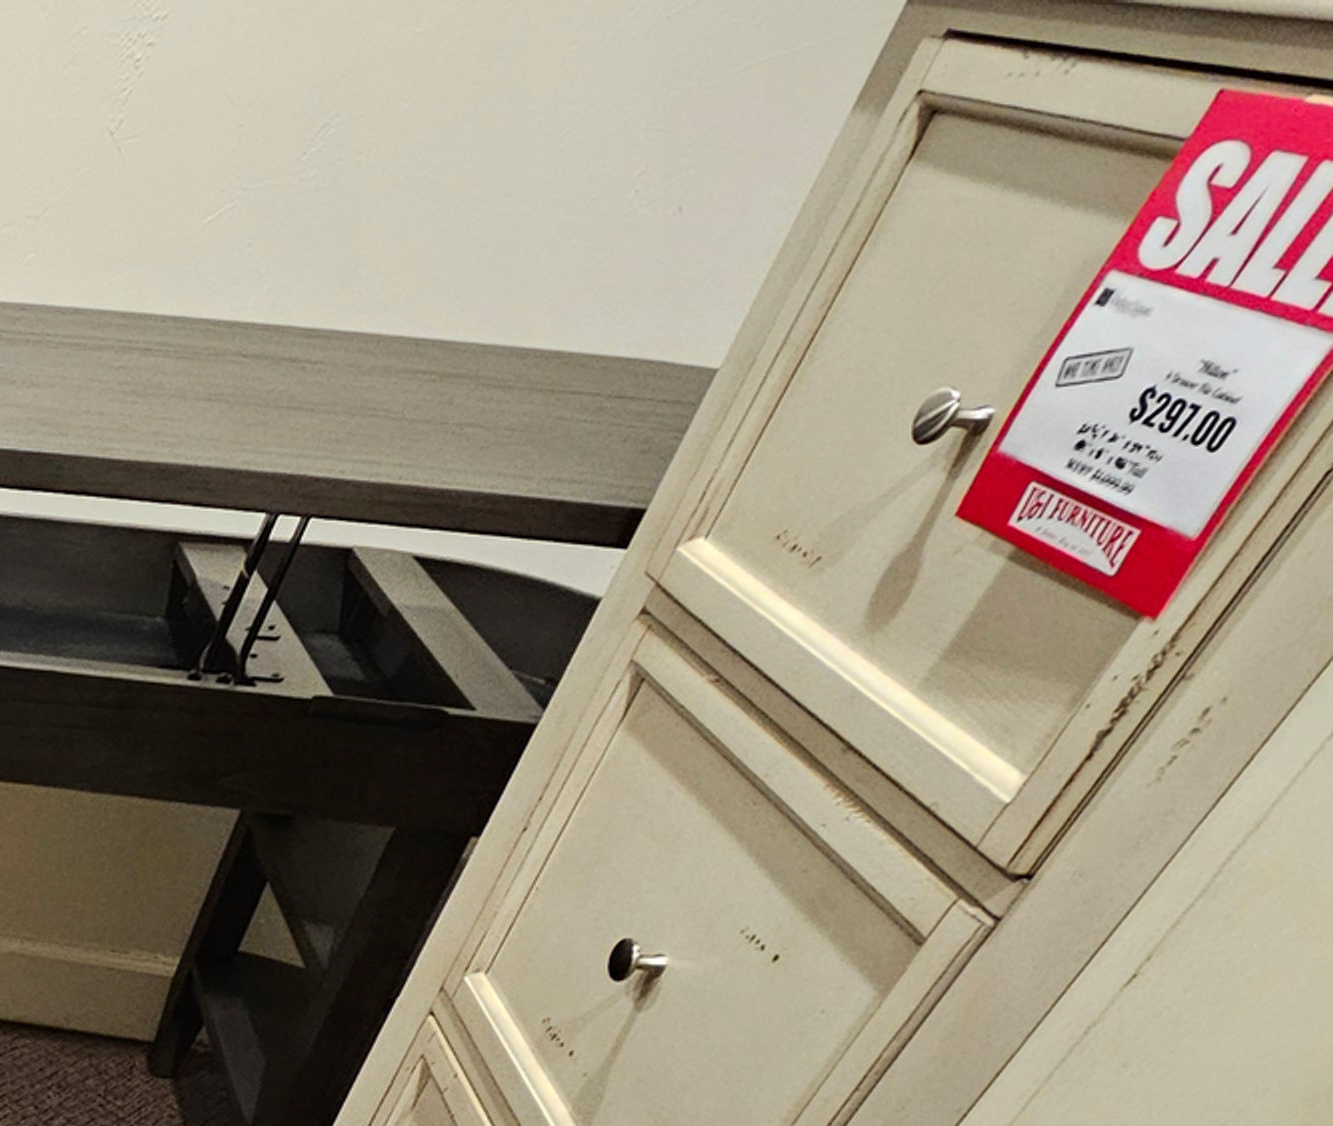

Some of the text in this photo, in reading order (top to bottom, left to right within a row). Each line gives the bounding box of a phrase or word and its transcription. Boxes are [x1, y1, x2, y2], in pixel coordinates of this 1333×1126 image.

[1130, 384, 1238, 454] $297.00
[1016, 486, 1054, 523] U&I
[1049, 496, 1134, 568] FURNITURE
